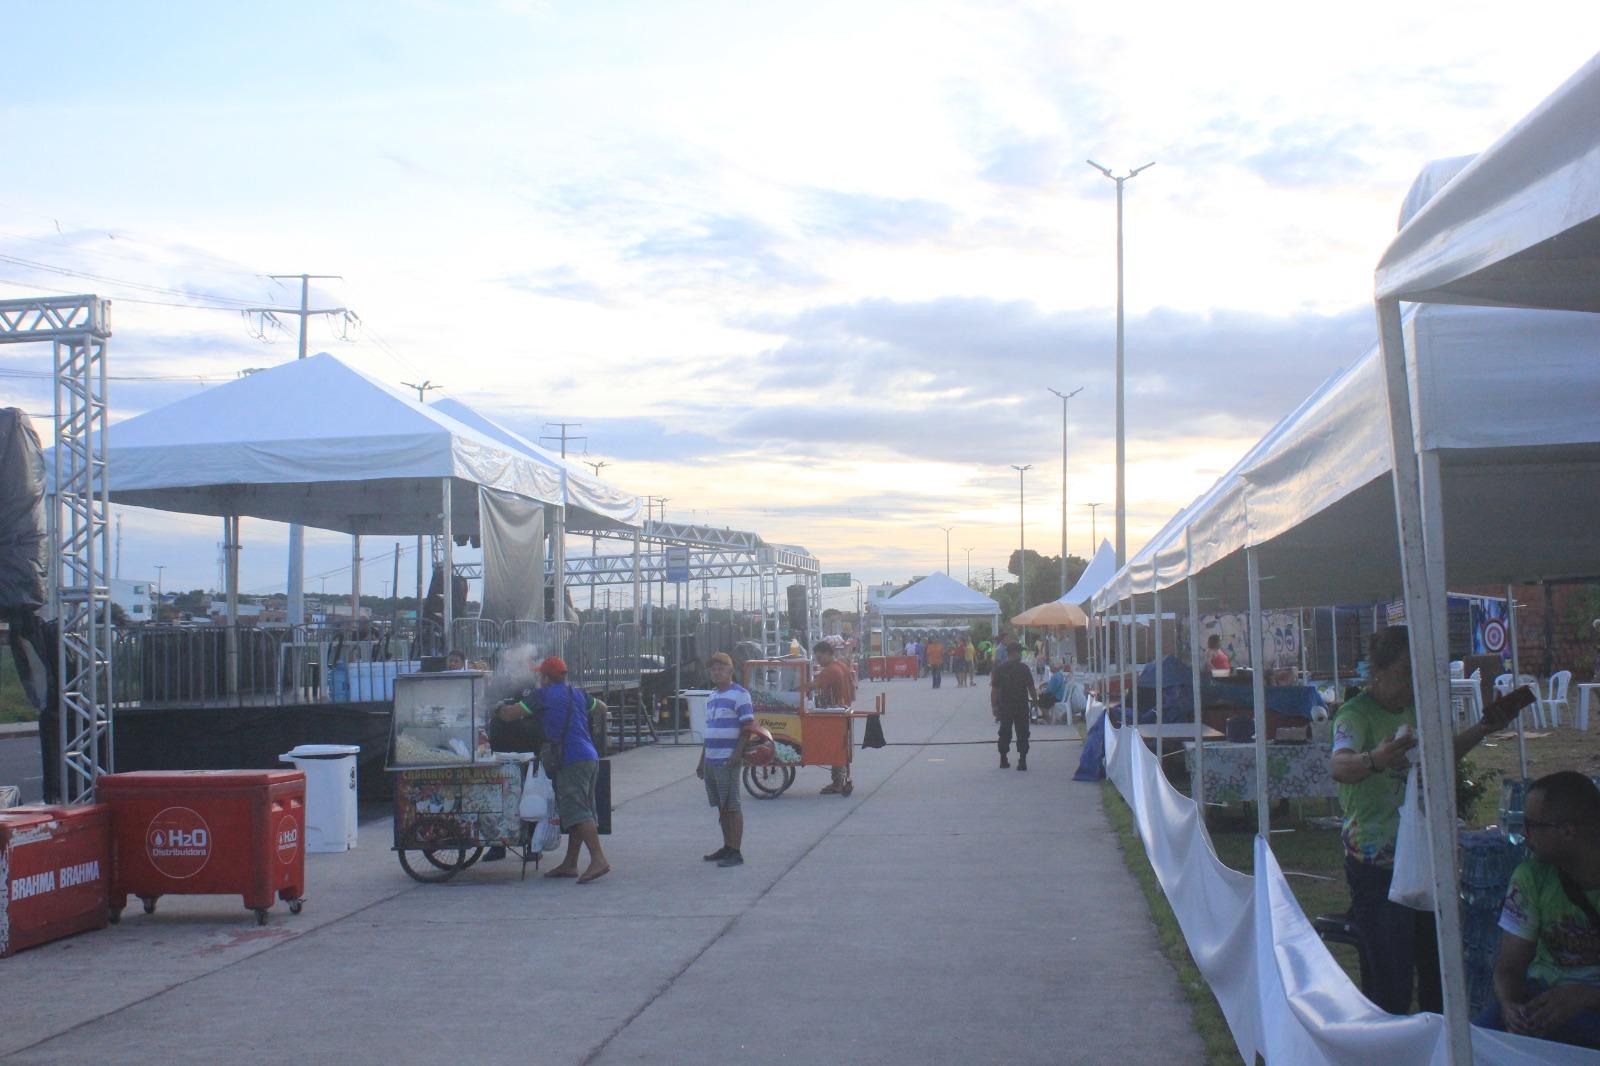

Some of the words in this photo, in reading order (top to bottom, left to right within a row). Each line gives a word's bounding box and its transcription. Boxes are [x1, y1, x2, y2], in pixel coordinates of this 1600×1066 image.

[169, 828, 207, 847] H2O
[152, 848, 207, 856] Distribuidora
[12, 871, 55, 901] BRAHMA
[60, 860, 100, 889] BRAHMA
